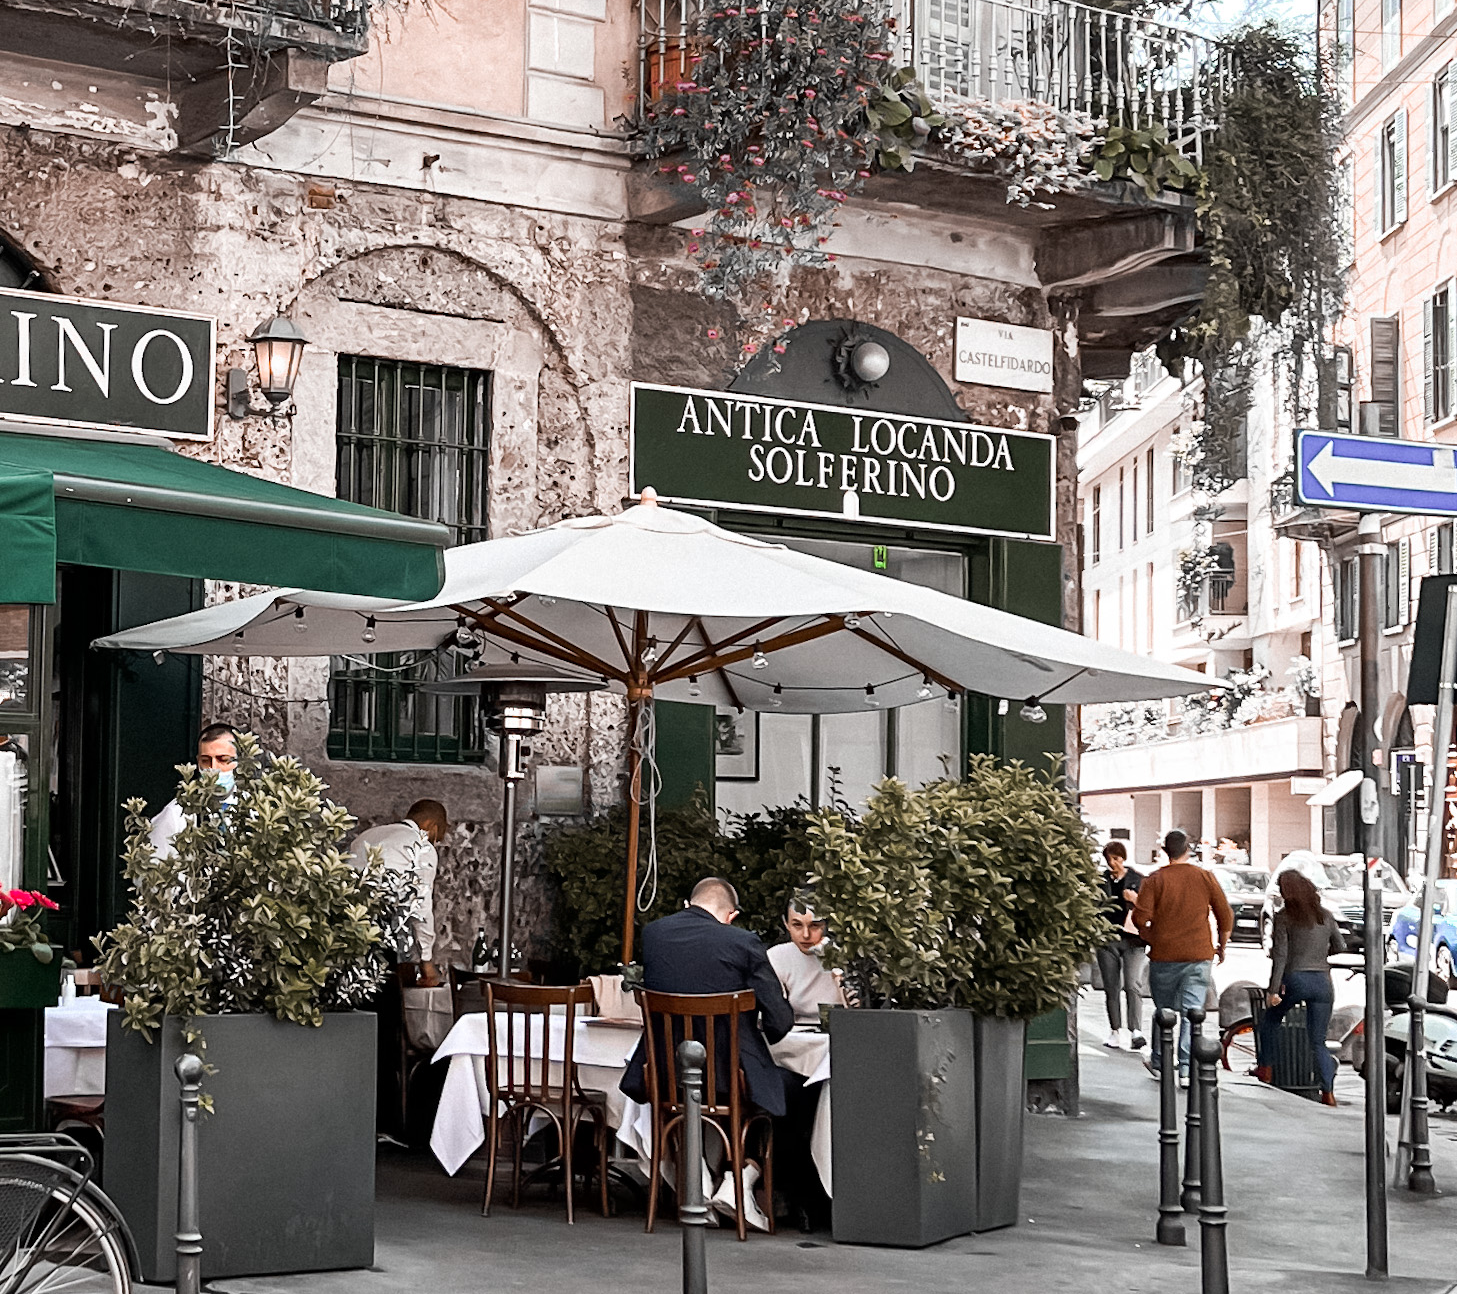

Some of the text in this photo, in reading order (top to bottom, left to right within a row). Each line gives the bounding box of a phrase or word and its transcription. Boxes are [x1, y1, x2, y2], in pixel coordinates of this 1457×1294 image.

[997, 329, 1014, 341] VIA
[958, 349, 1051, 375] CASTELFIDARDO
[676, 394, 1016, 472] ANTICA LOCANDA
[747, 443, 956, 503] SOLFERINO
